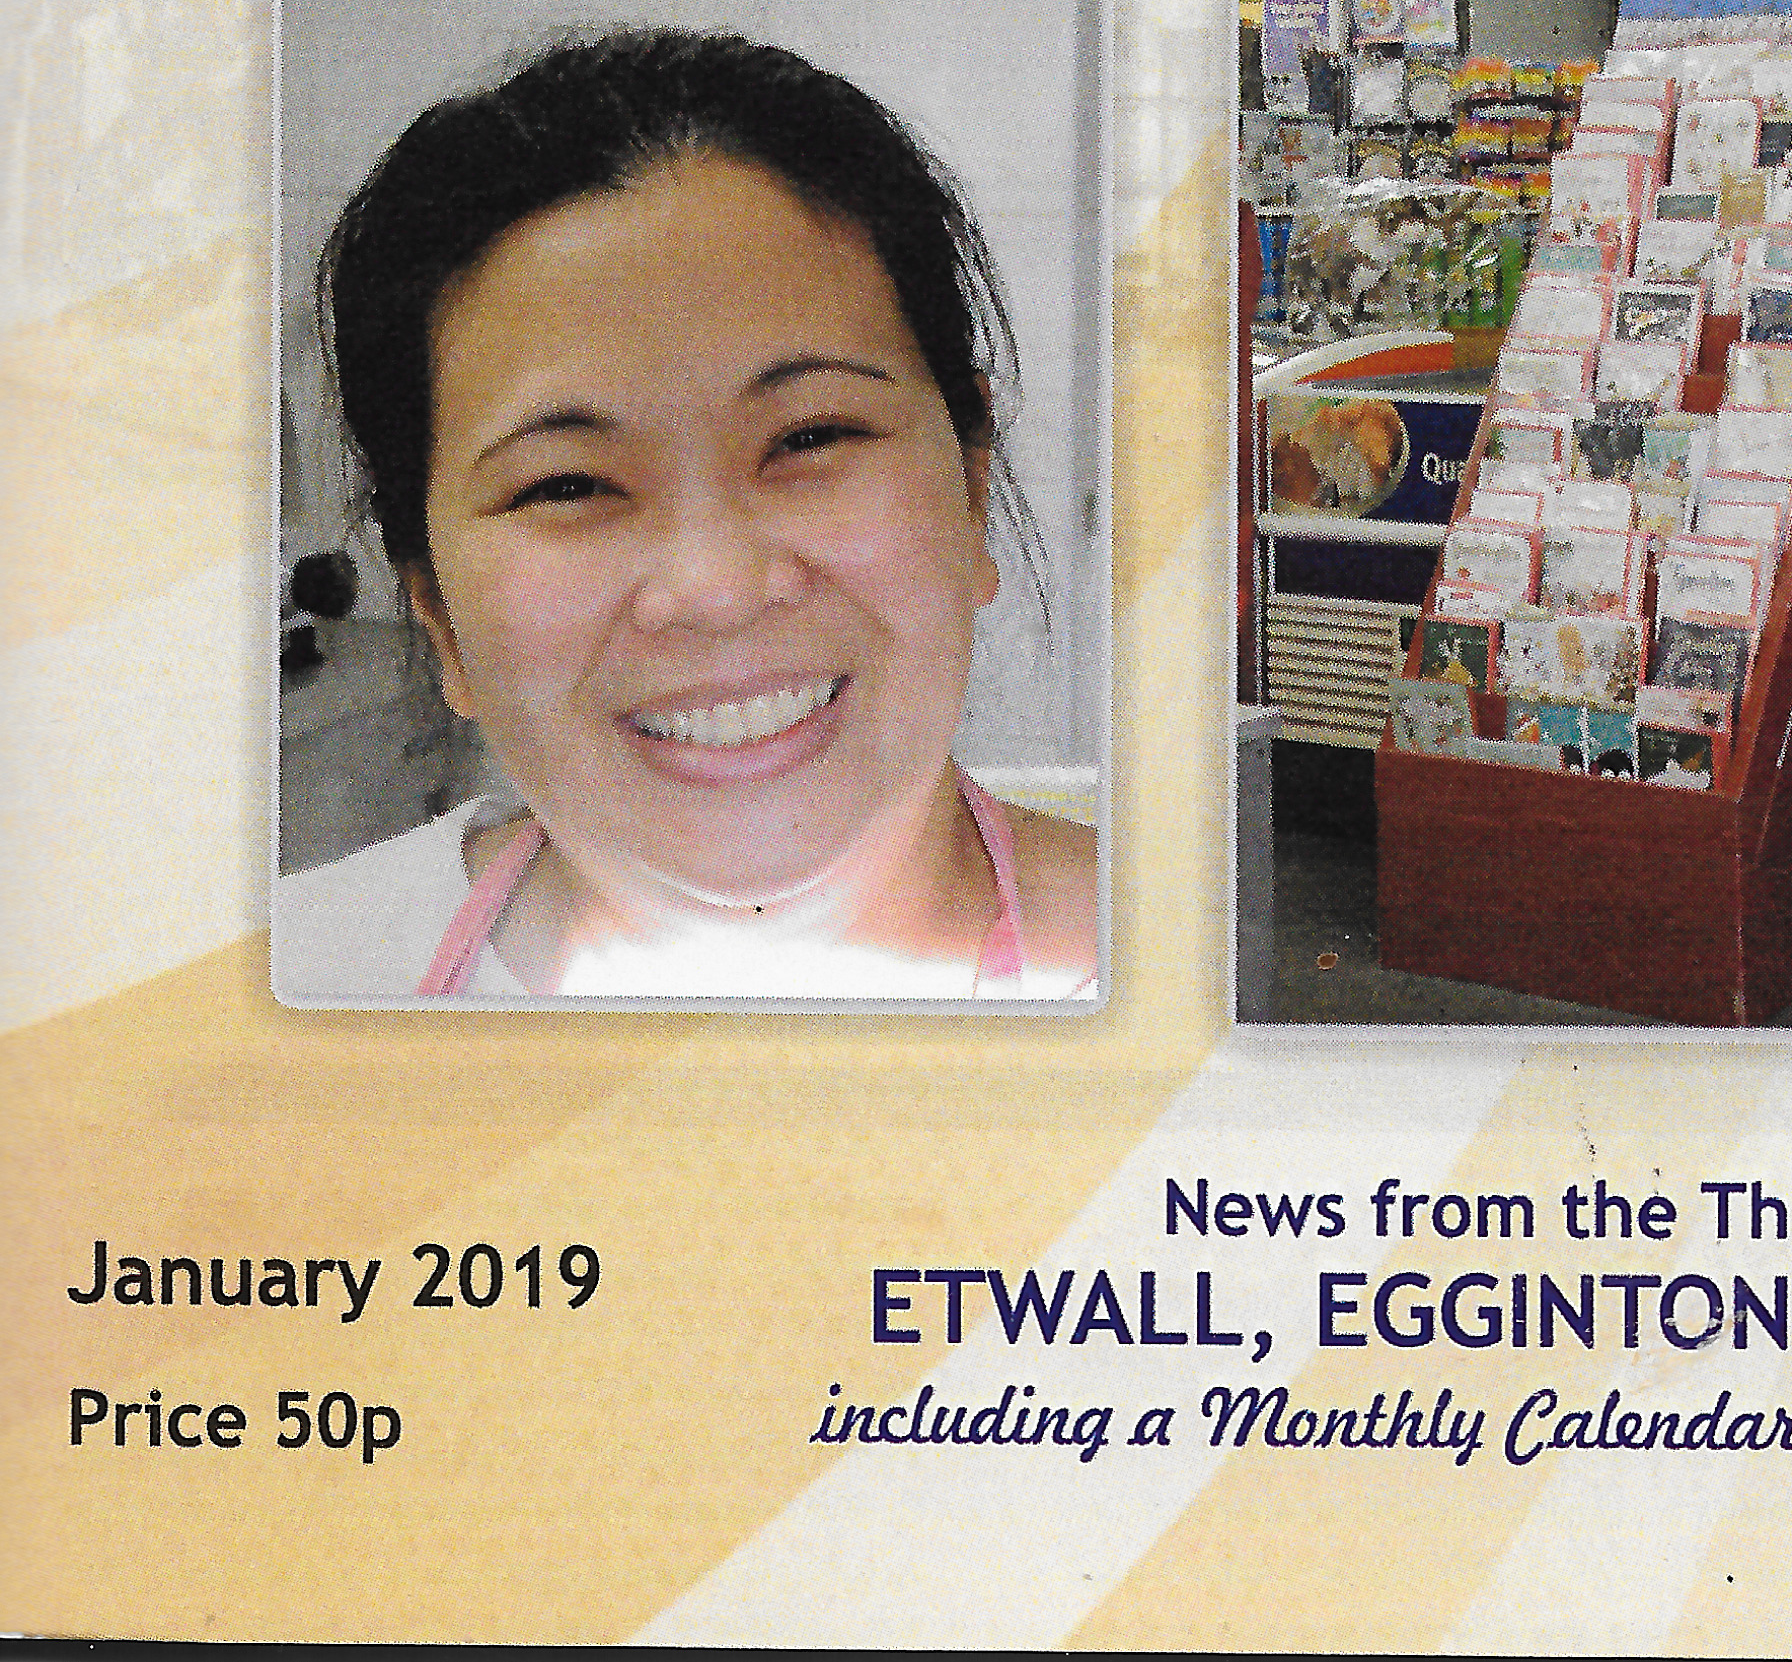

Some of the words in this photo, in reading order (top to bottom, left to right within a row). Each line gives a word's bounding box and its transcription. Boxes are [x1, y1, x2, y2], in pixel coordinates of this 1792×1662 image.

[1166, 1178, 1346, 1238] News
[1371, 1179, 1534, 1239] from
[1562, 1179, 1677, 1240] the
[67, 1240, 381, 1324] January
[412, 1243, 600, 1309] 2019
[873, 1269, 1272, 1361] ETWALL,
[1319, 1272, 1788, 1350] EGGINTON
[70, 1388, 247, 1449] Price
[277, 1391, 402, 1465] 50p
[810, 1383, 1112, 1463] including
[1127, 1400, 1175, 1447] a
[1201, 1386, 1485, 1466] Monthly
